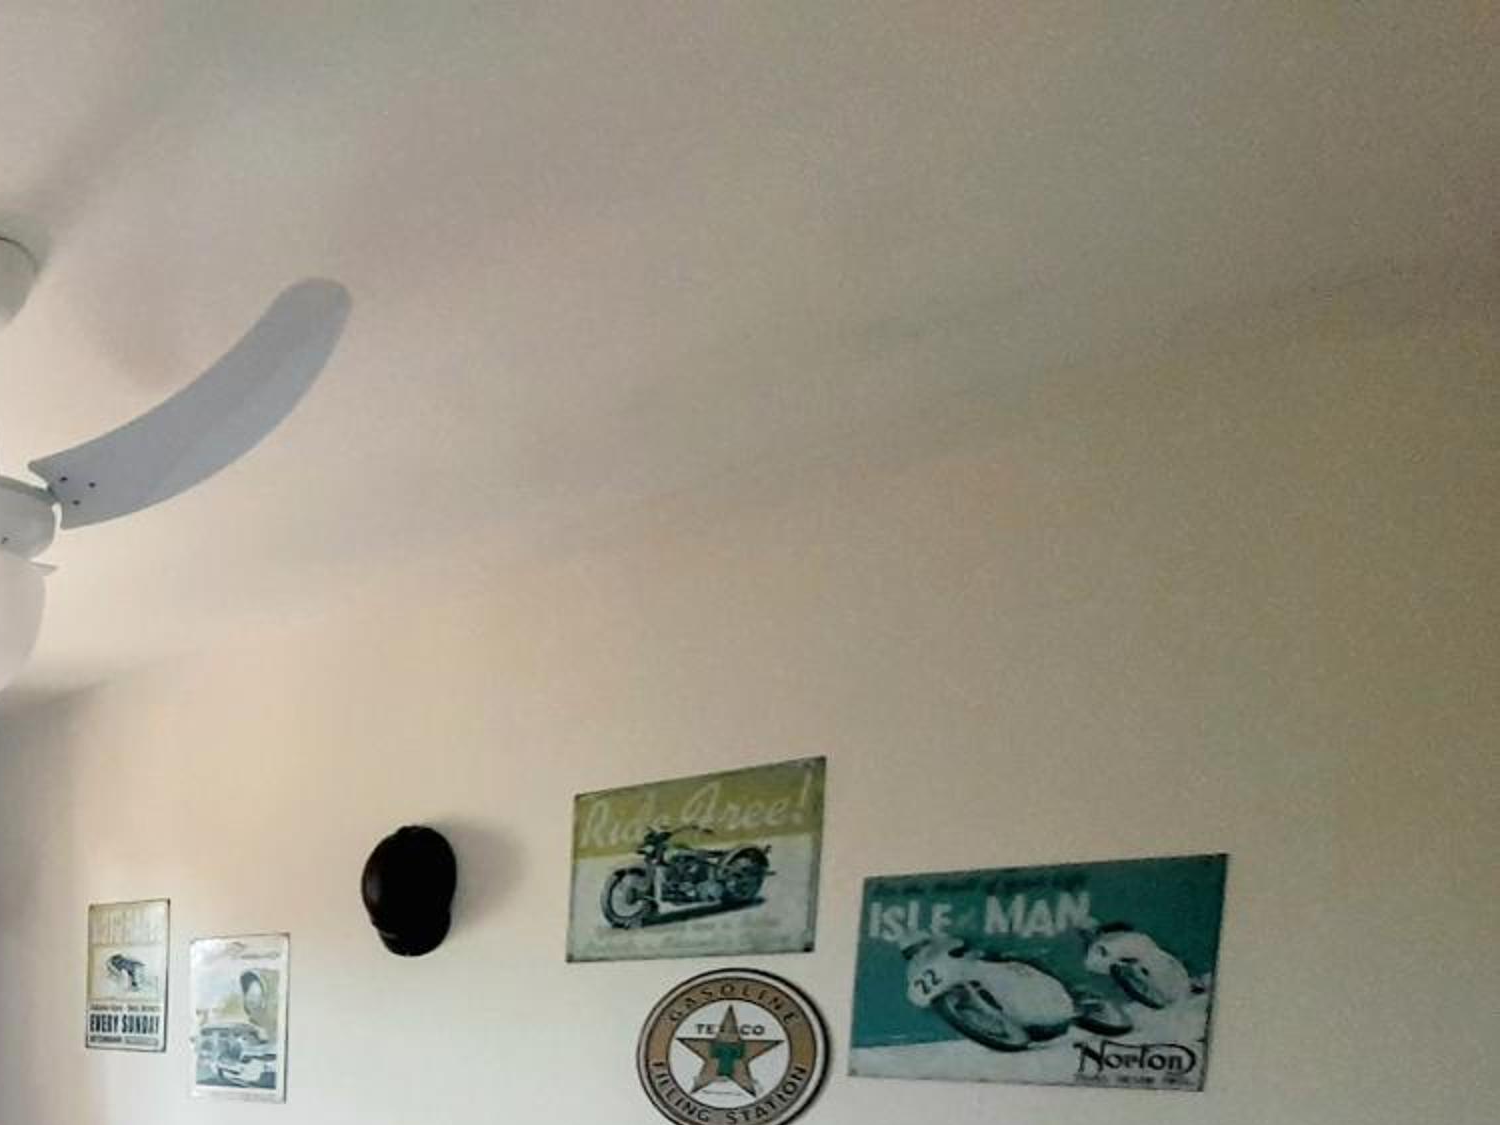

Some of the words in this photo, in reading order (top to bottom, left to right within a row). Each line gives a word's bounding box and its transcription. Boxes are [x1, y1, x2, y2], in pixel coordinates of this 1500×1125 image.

[868, 900, 954, 943] ISLE
[983, 891, 1093, 938] MAN
[913, 968, 943, 996] 22
[669, 983, 798, 1025] GASOLINE
[695, 1023, 765, 1035] TECO
[1073, 1040, 1196, 1075] Norton
[652, 1061, 709, 1123] FILLING
[725, 1065, 807, 1125] STATION
